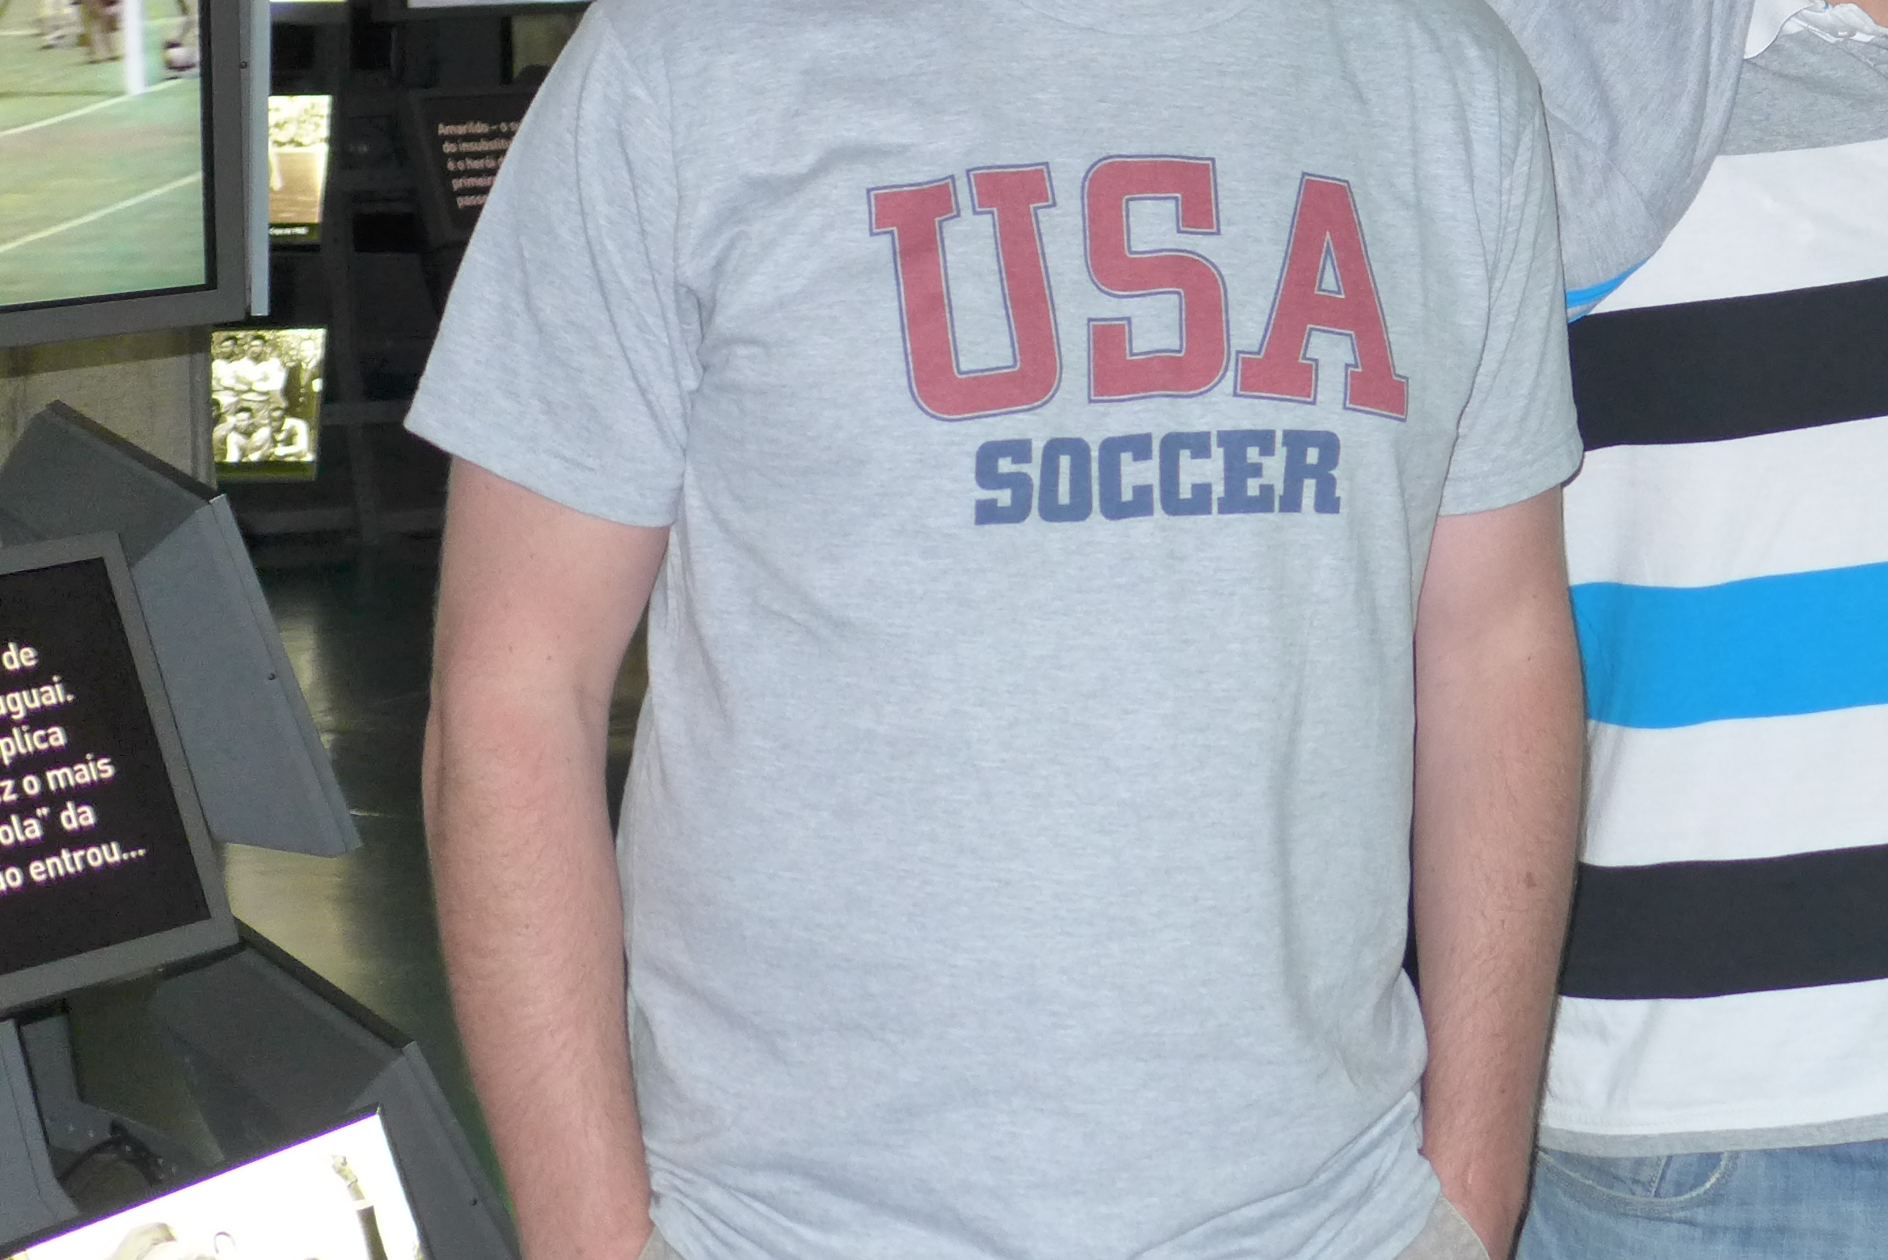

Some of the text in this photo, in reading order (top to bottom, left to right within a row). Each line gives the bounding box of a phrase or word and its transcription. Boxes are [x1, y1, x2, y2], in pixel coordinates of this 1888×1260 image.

[867, 155, 1409, 422] USA
[974, 430, 1341, 525] SOCCER
[2, 642, 39, 670] de
[22, 774, 41, 796] o
[46, 752, 116, 792] mais
[60, 800, 97, 831] da
[29, 841, 147, 882] entrou...
